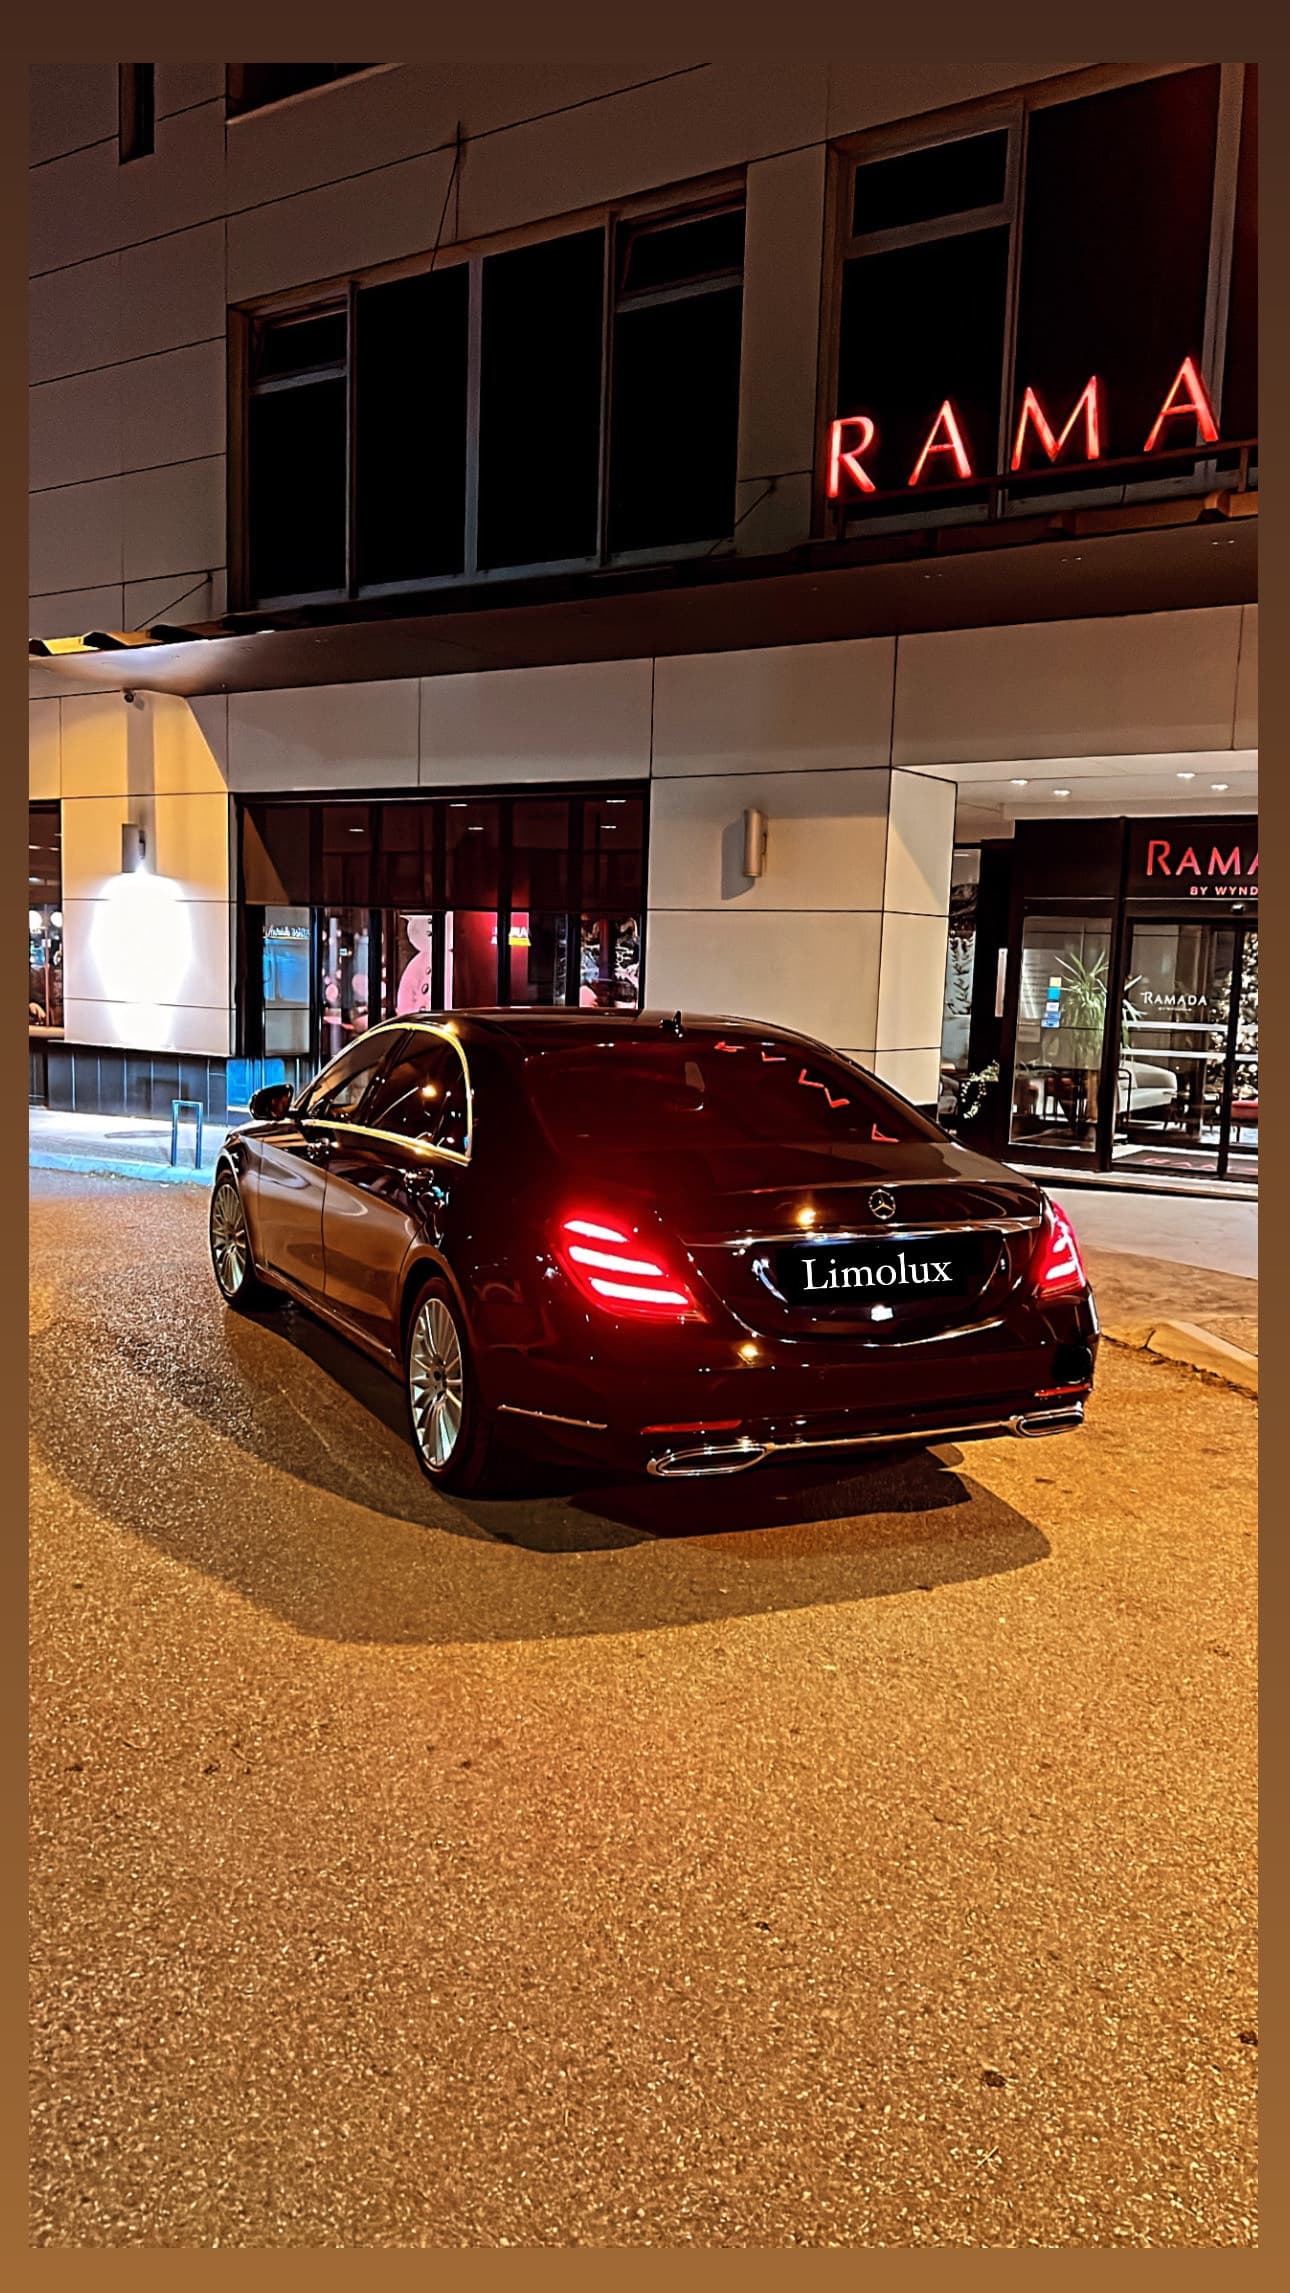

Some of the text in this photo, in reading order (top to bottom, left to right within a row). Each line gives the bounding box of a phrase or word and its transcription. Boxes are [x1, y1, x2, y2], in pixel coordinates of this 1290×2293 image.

[827, 357, 1220, 498] RAMA
[1189, 885, 1208, 896] BY
[1141, 991, 1208, 1006] RAMADA
